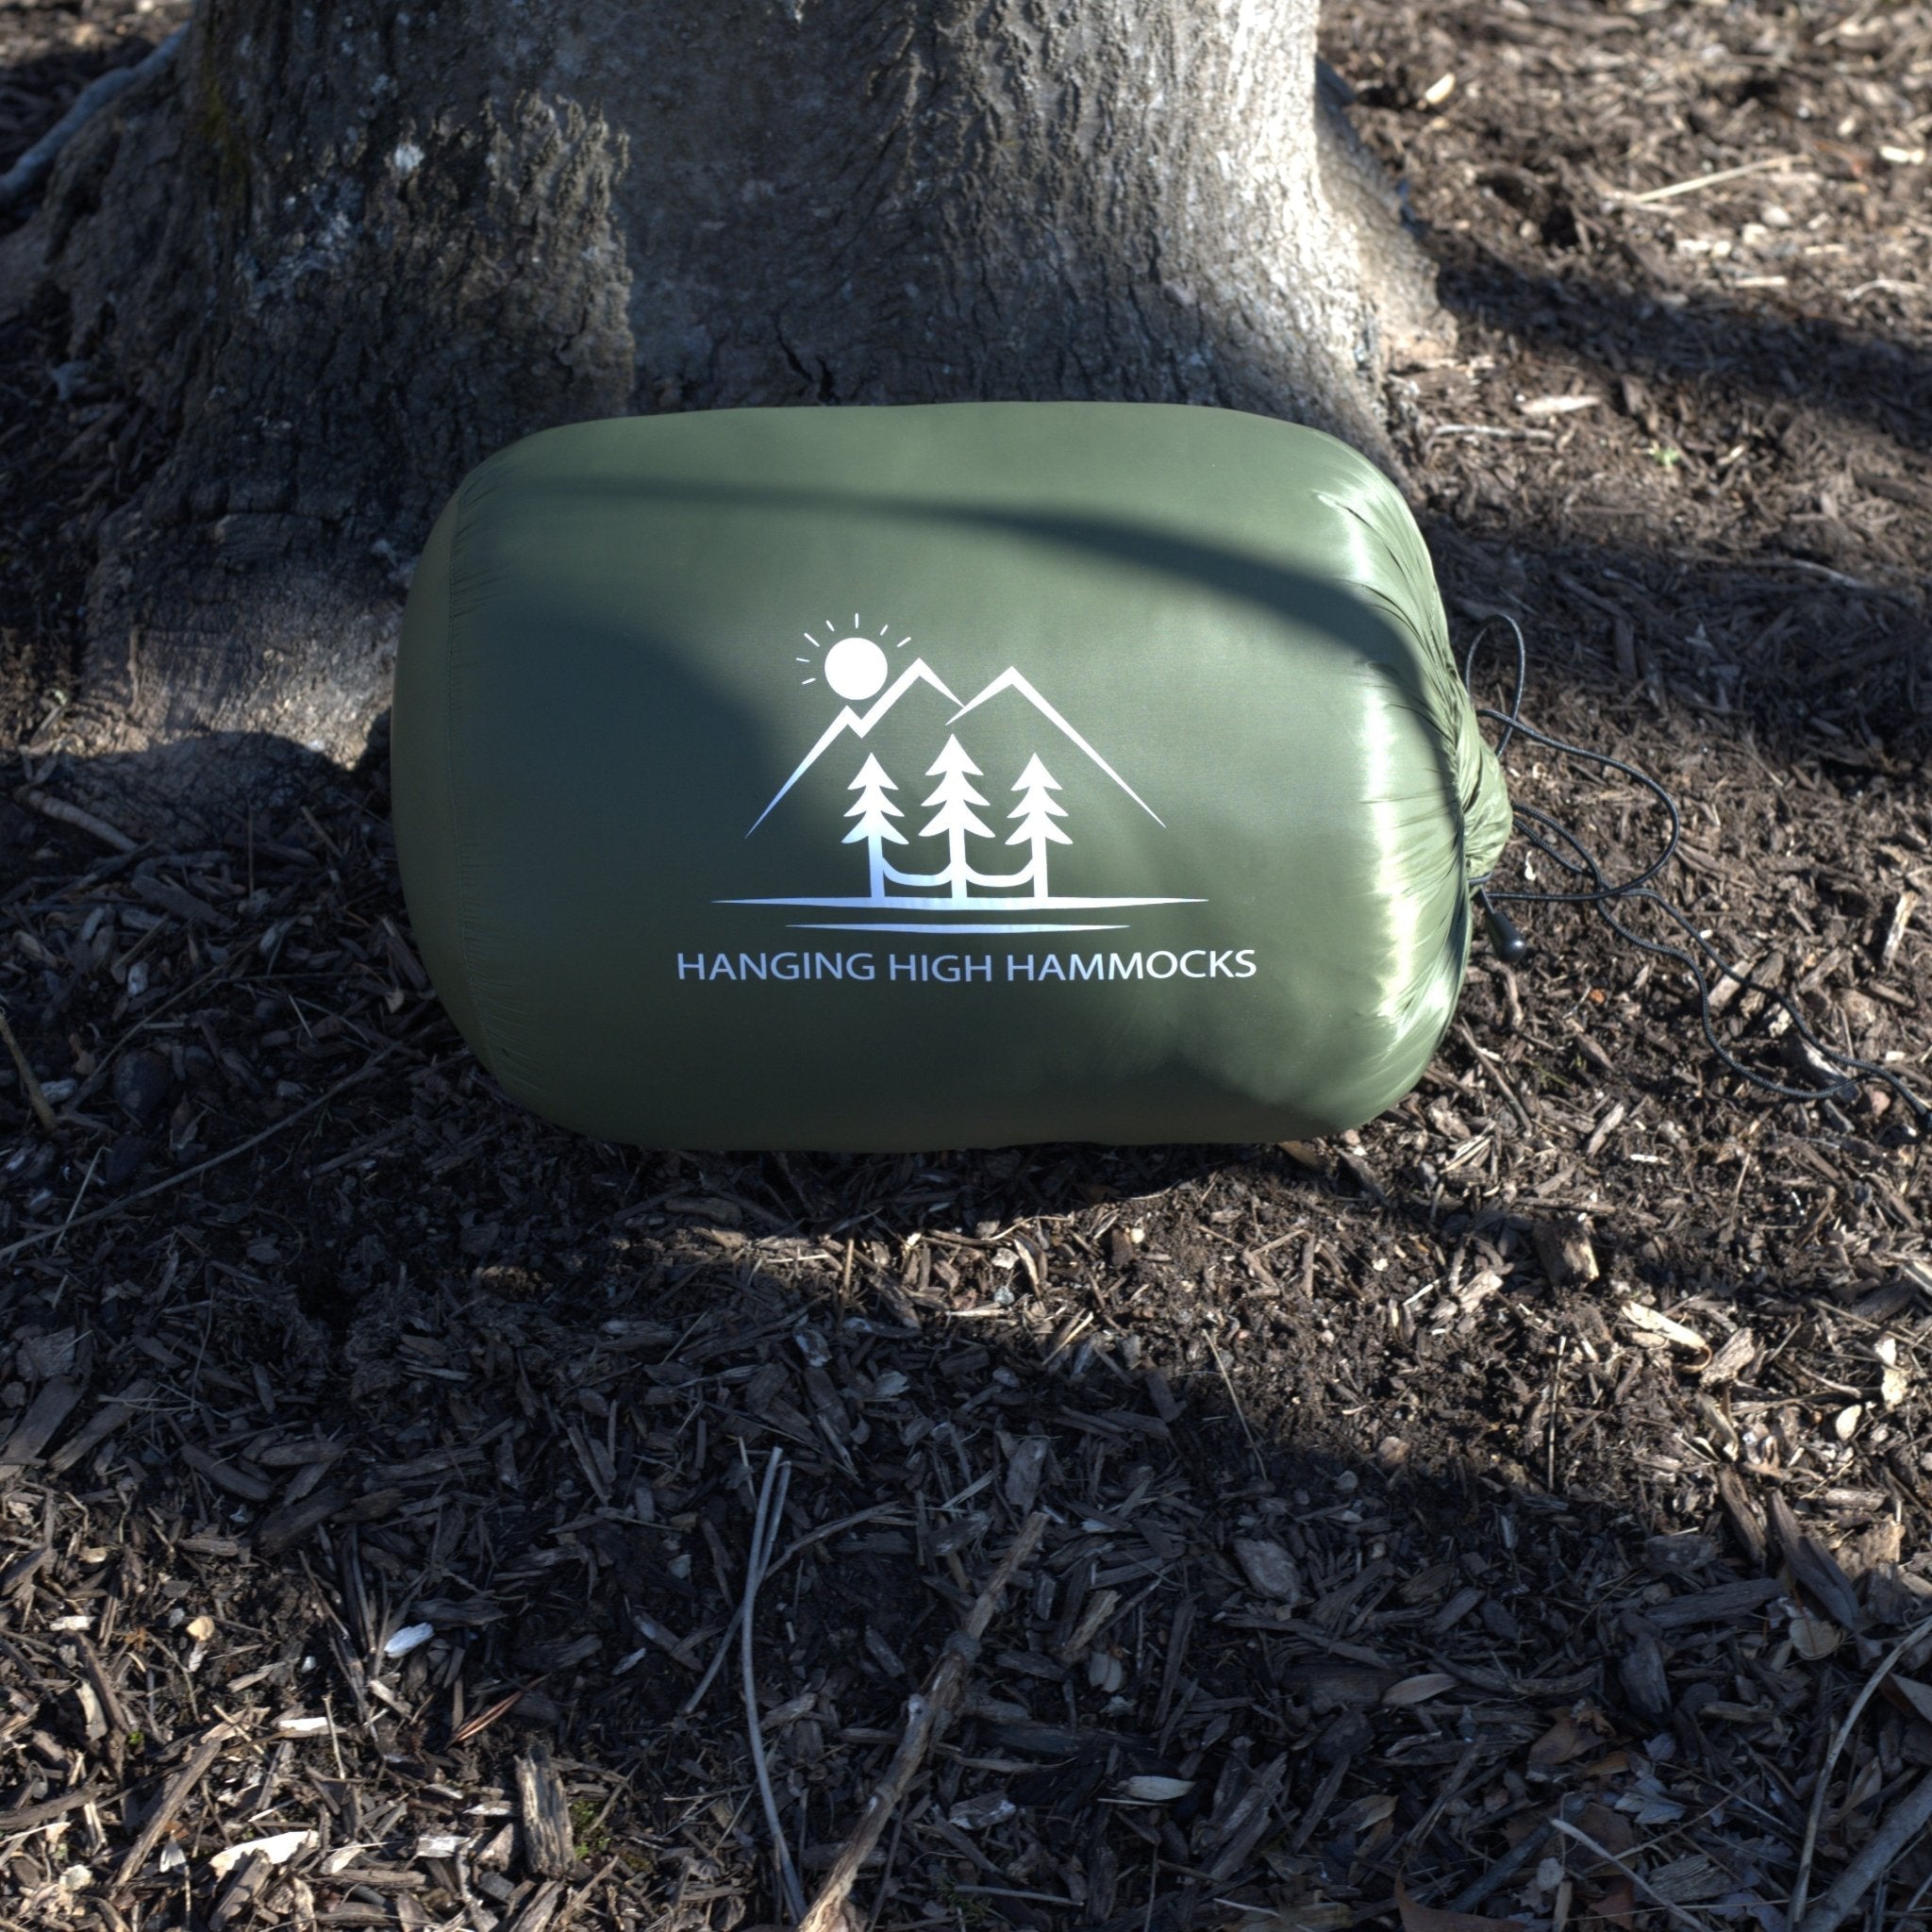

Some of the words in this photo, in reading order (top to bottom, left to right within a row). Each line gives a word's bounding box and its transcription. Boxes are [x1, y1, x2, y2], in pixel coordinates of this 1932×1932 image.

[677, 952, 874, 980] HANGING
[890, 954, 992, 982] HIGH
[1007, 949, 1257, 981] HAMMOCKS
